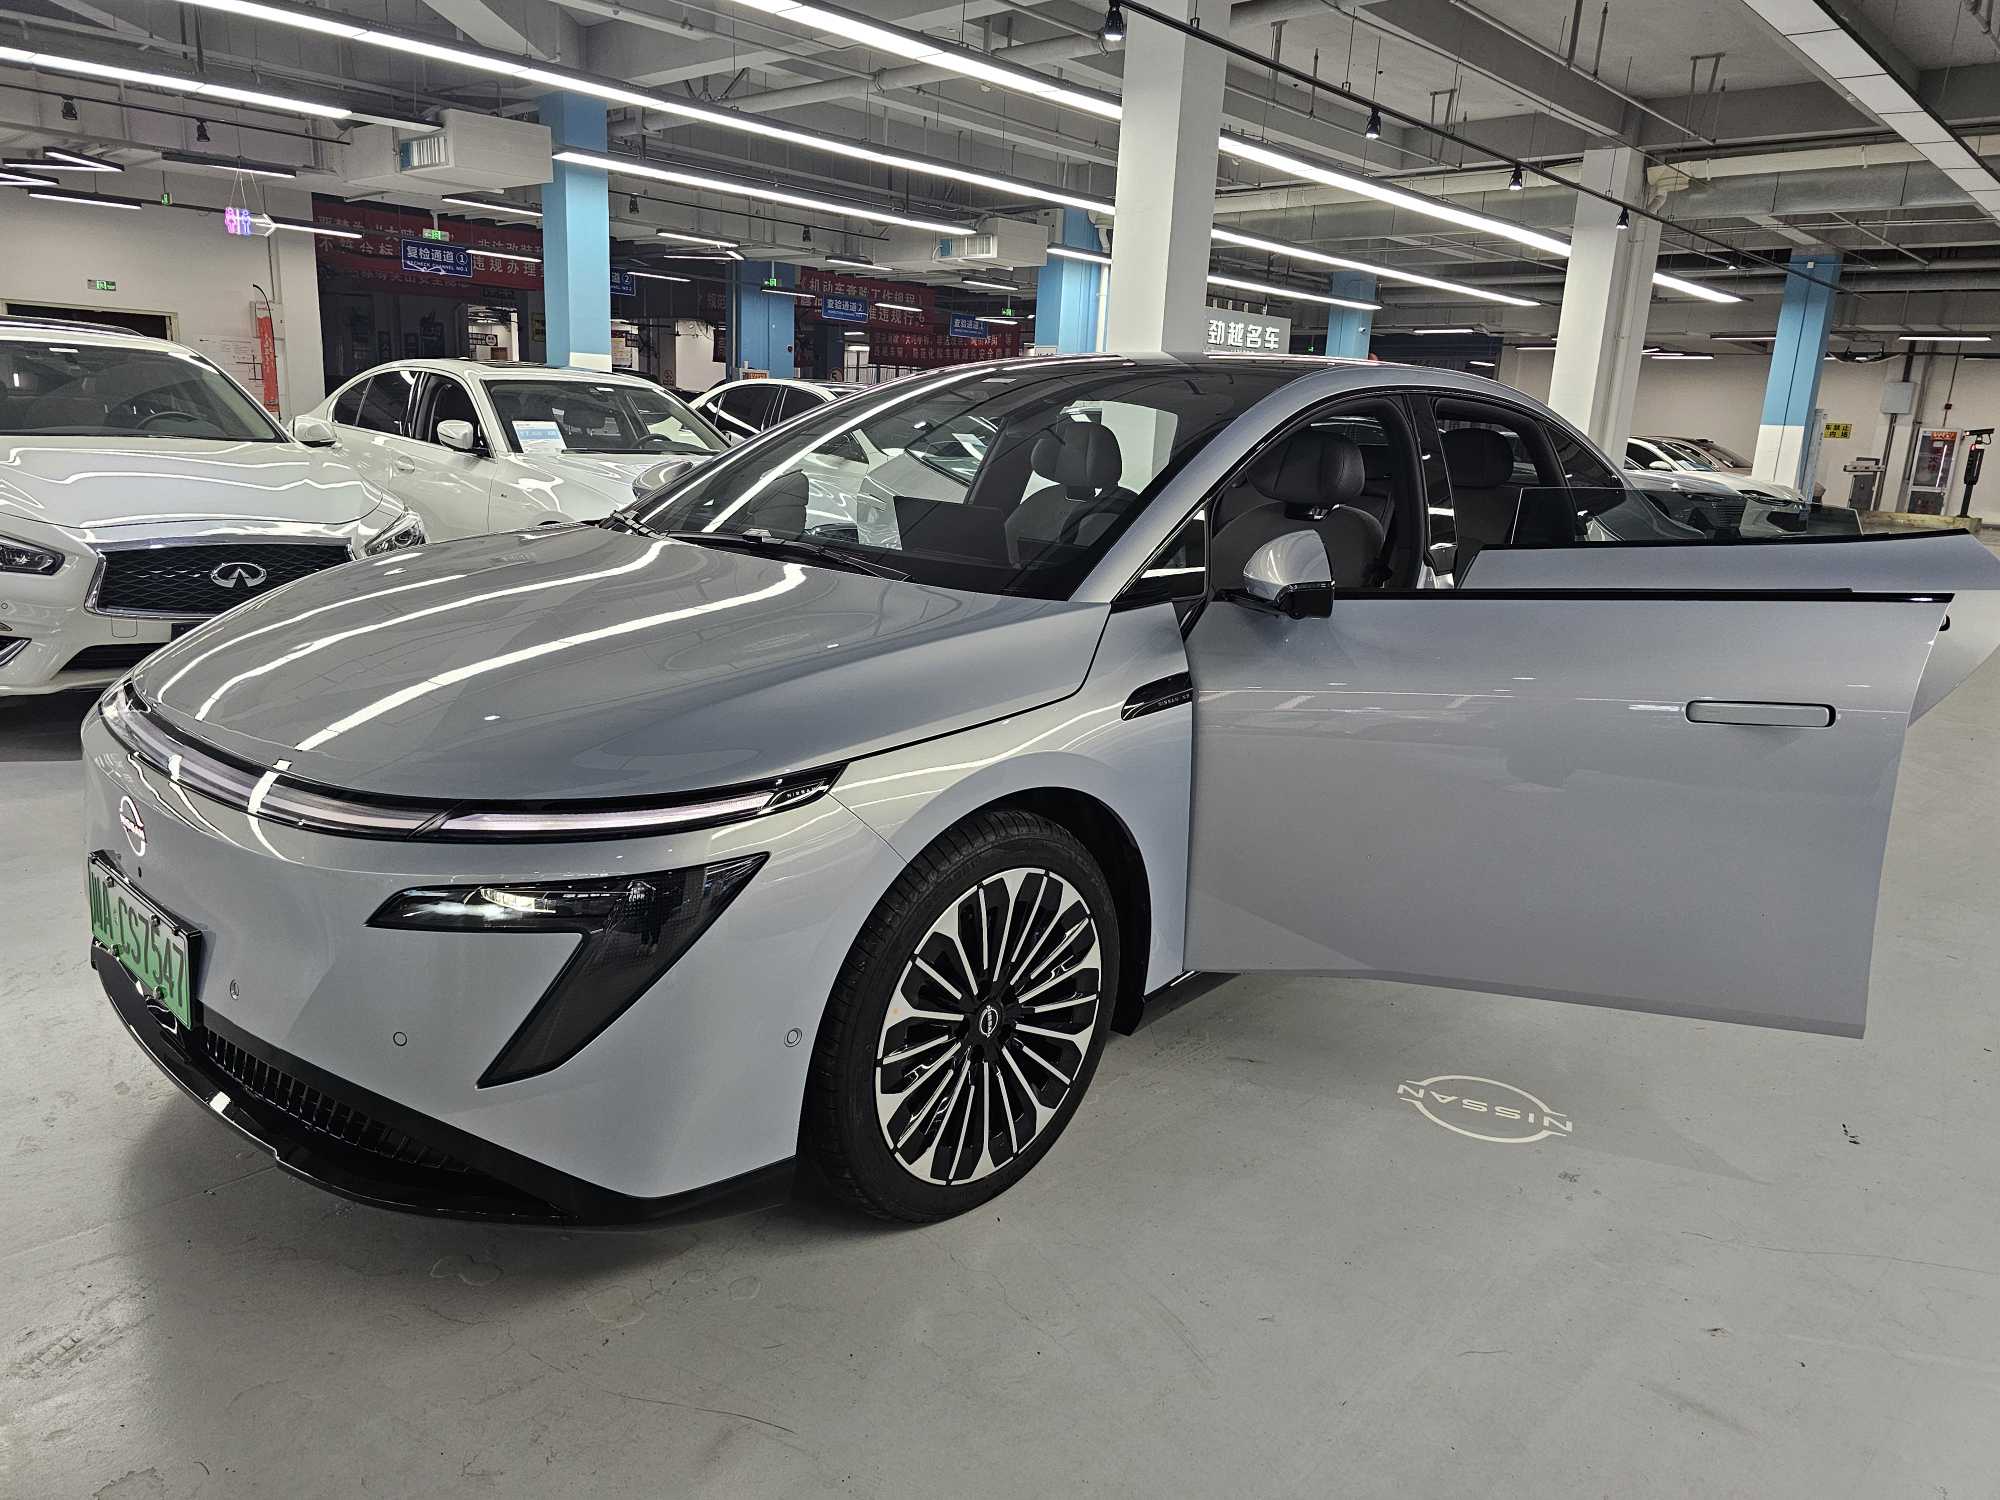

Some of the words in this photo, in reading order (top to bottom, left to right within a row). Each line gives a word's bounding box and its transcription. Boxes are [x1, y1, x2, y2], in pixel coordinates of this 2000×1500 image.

[1207, 319, 1280, 350] 劲越名车
[1397, 1084, 1573, 1133] NISSAN
